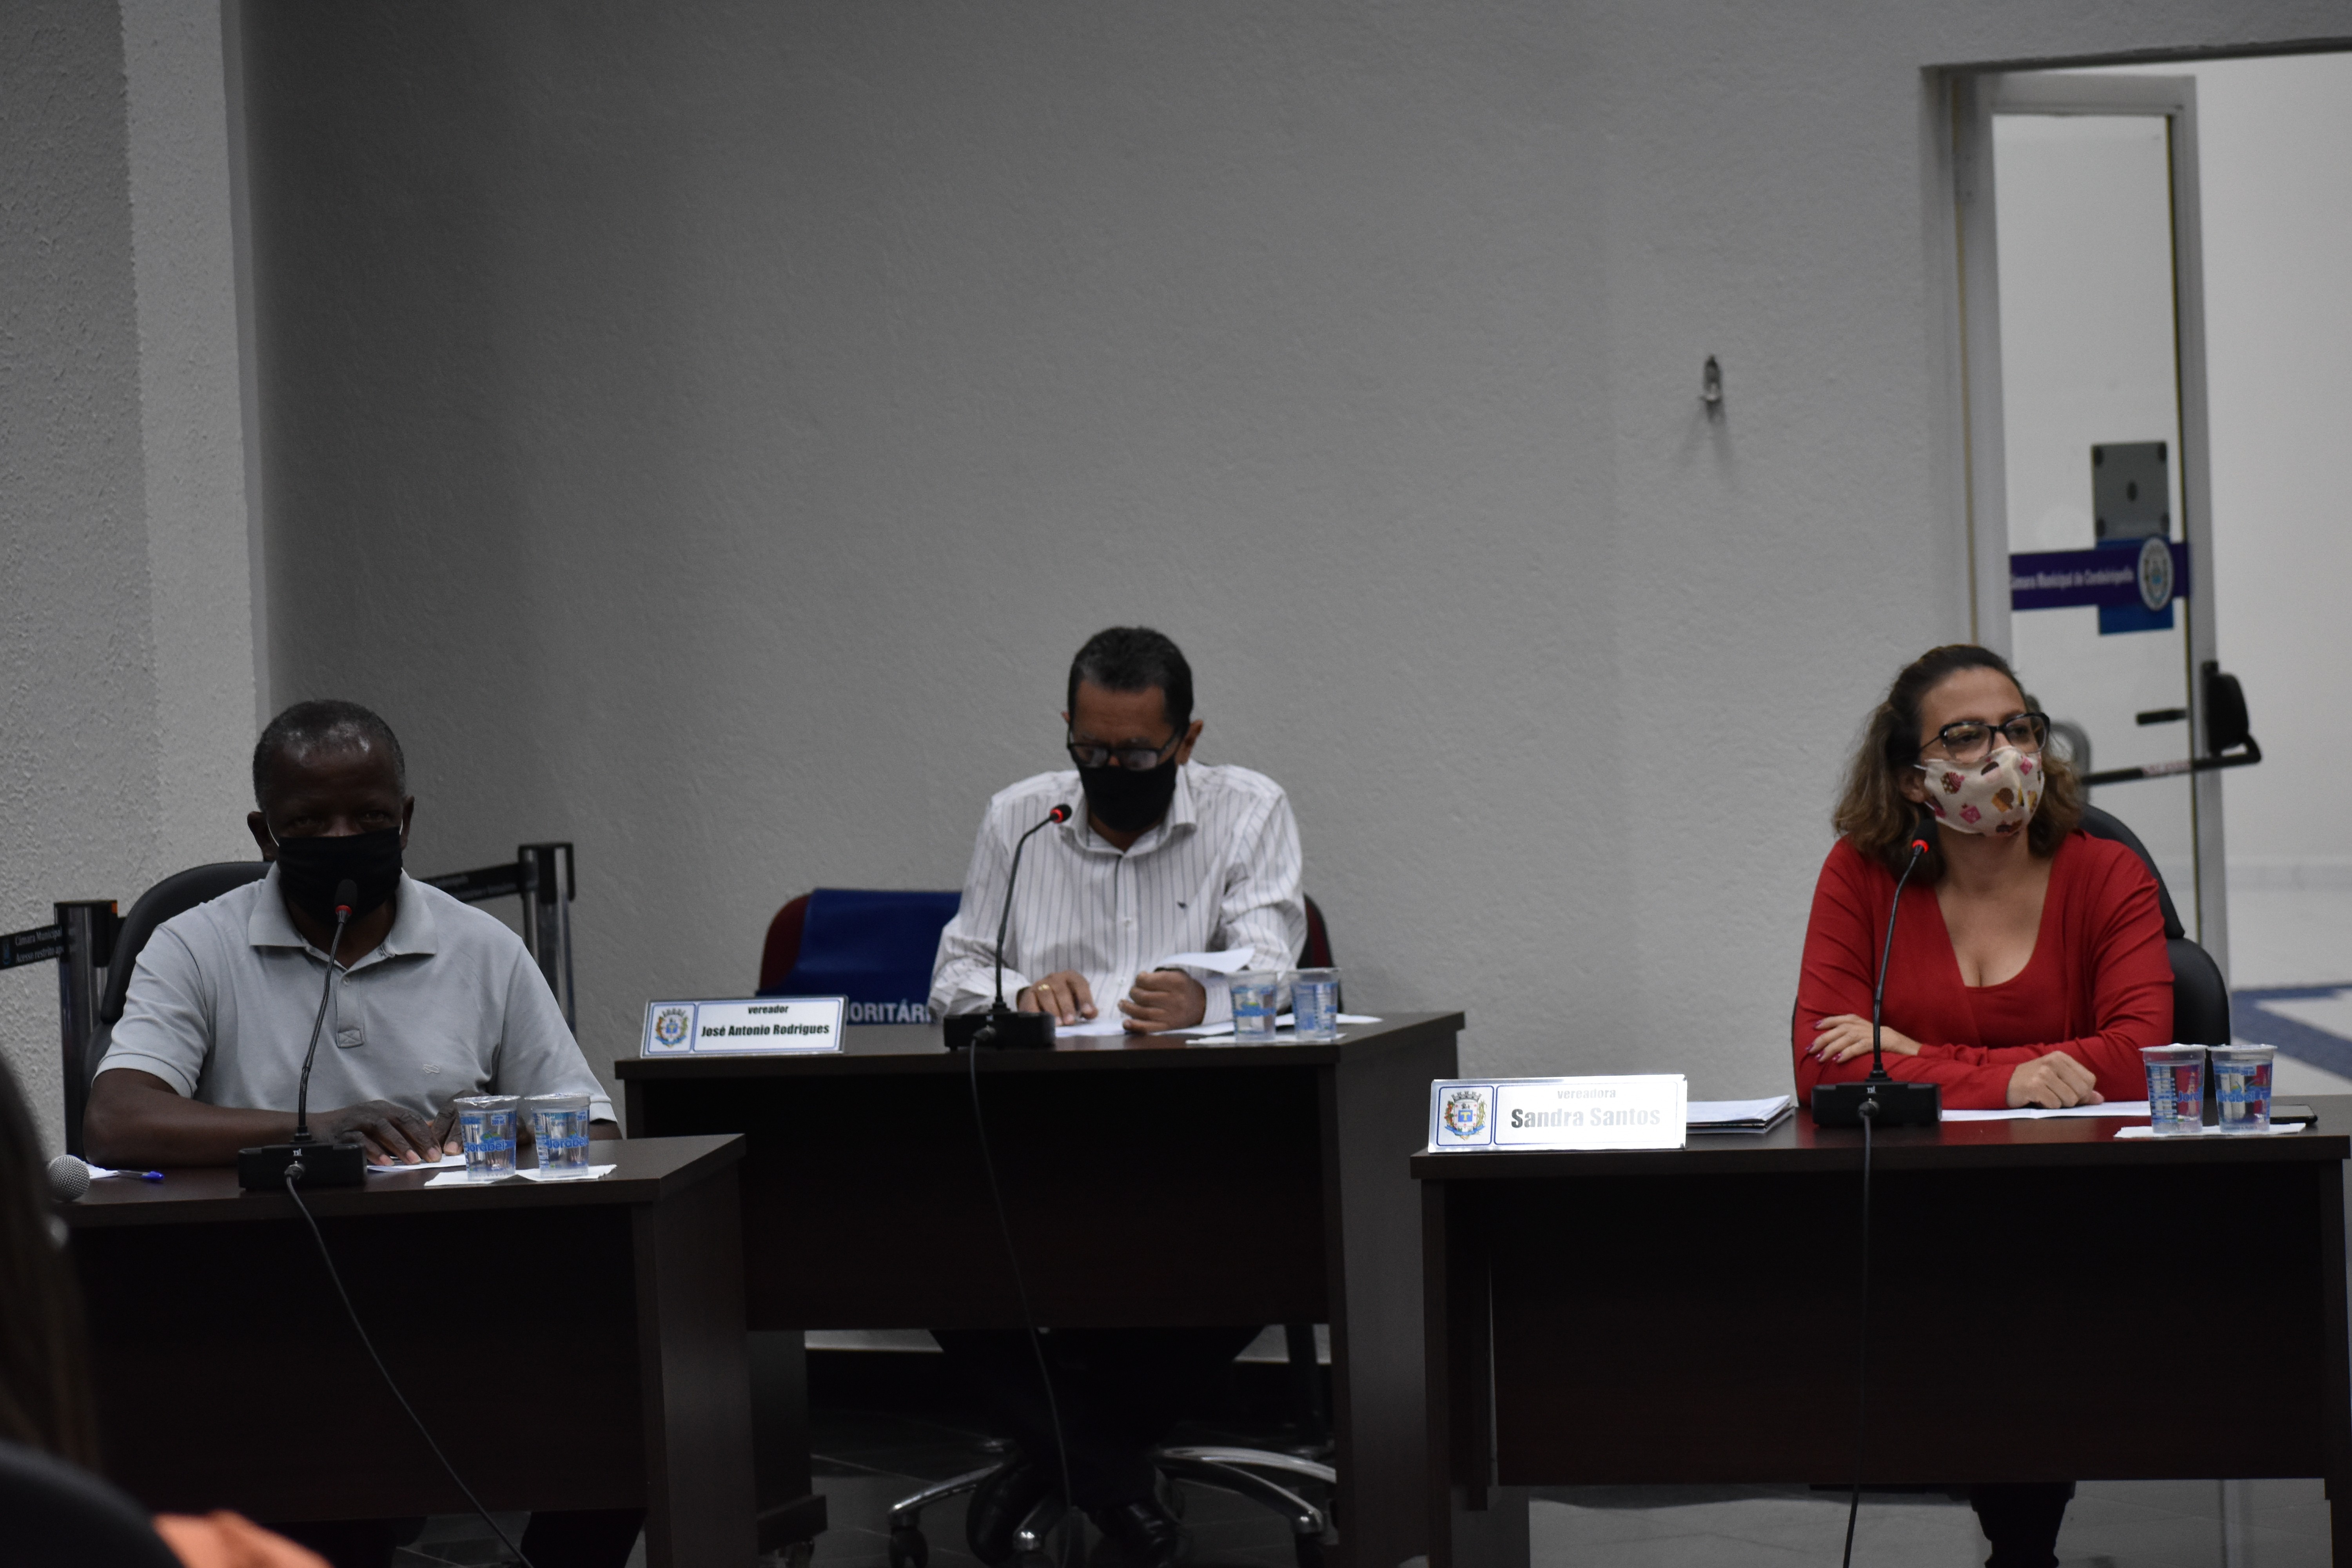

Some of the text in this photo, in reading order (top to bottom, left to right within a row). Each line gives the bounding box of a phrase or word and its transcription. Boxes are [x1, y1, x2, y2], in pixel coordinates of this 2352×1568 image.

[15, 935, 35, 947] Câmara
[748, 1005, 789, 1014] vereador
[702, 1024, 829, 1037] José Antonio Rodrigues
[1557, 1088, 1616, 1099] vereadora
[1511, 1107, 1661, 1128] Sandra Santos
